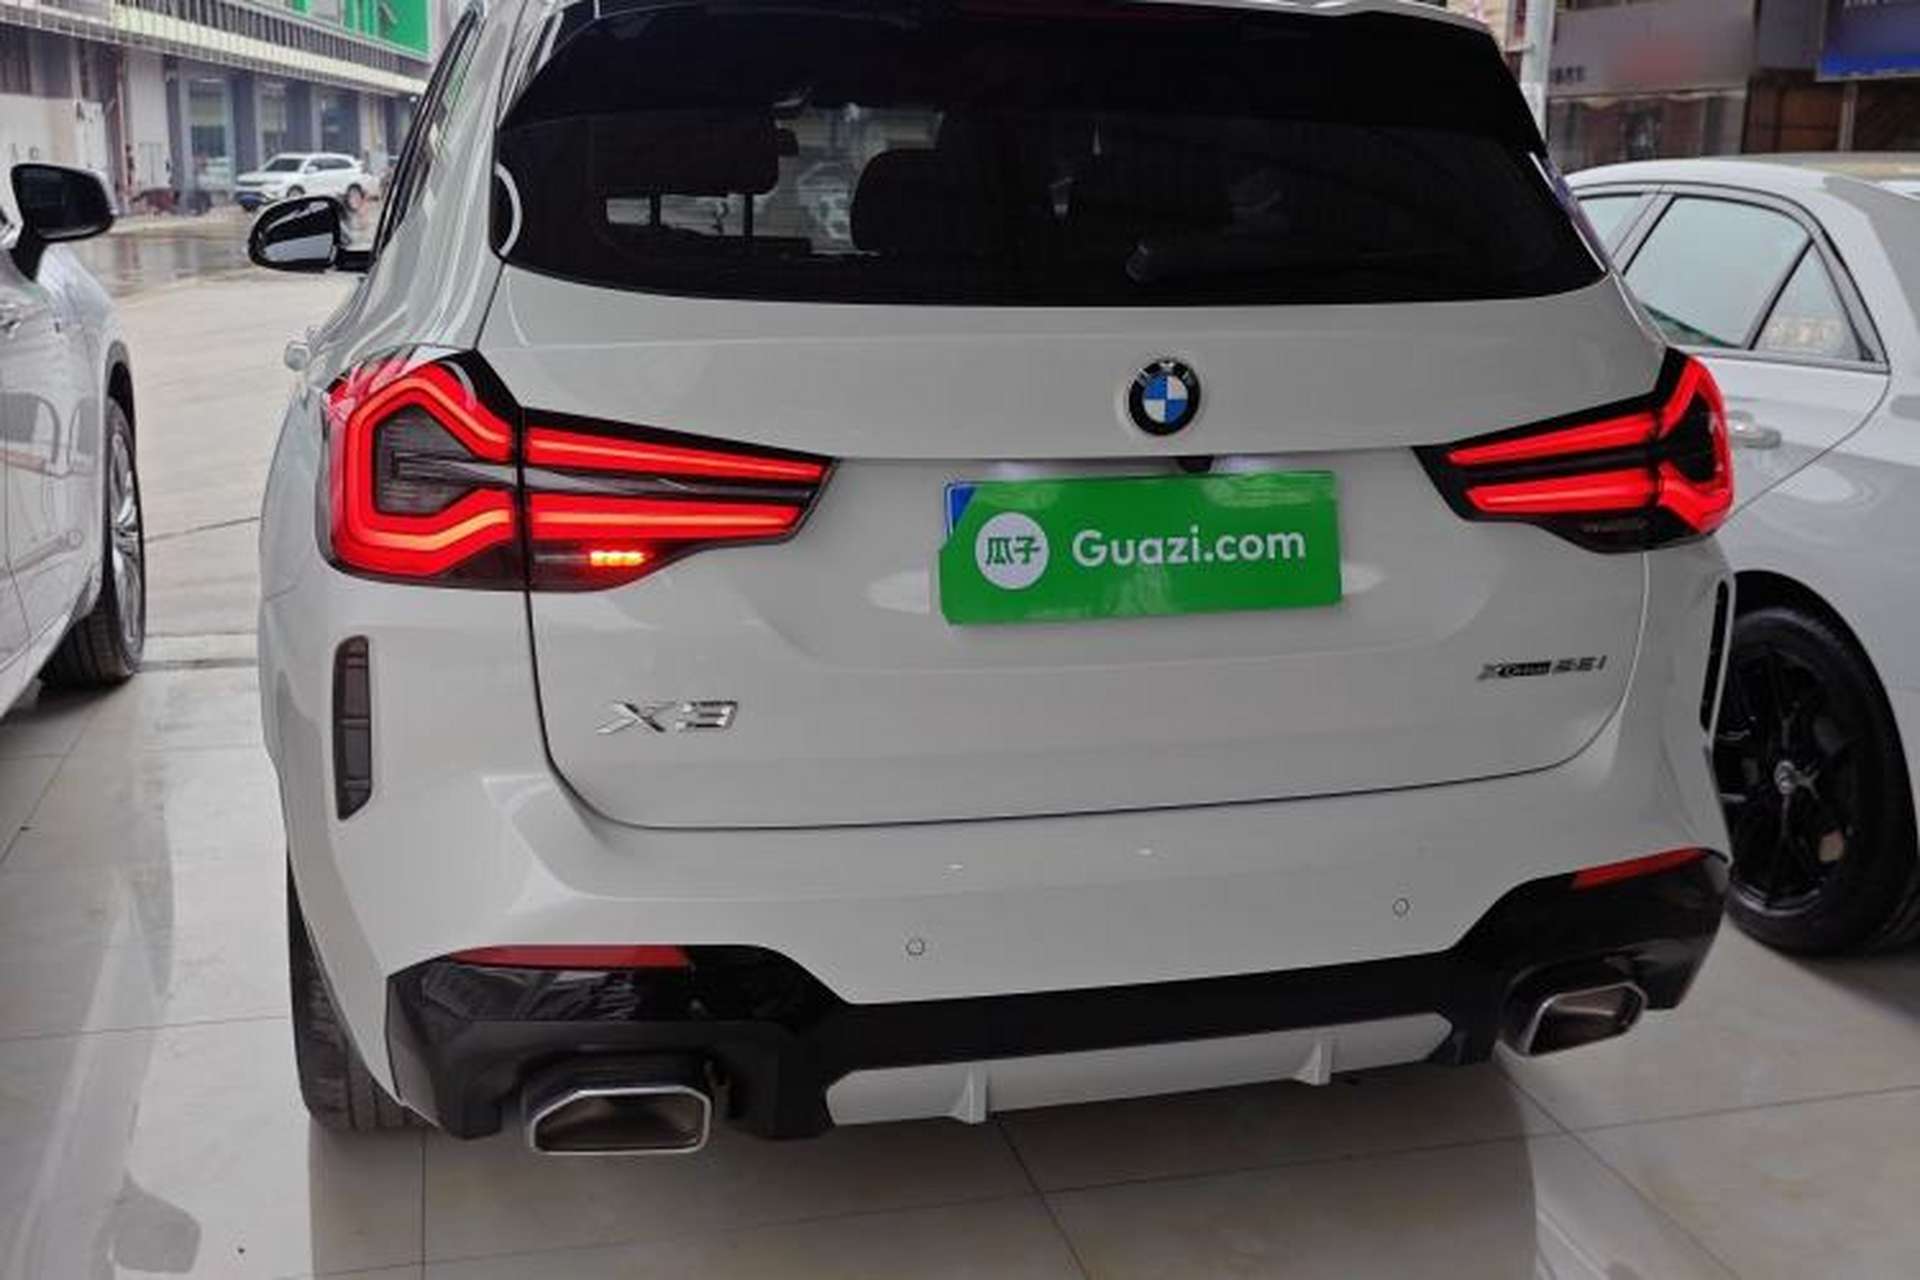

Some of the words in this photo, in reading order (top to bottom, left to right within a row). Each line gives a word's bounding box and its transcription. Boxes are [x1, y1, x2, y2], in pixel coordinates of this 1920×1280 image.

[985, 536, 1041, 567] 瓜子
[1072, 525, 1306, 568] Guazi.com
[597, 700, 738, 735] X3
